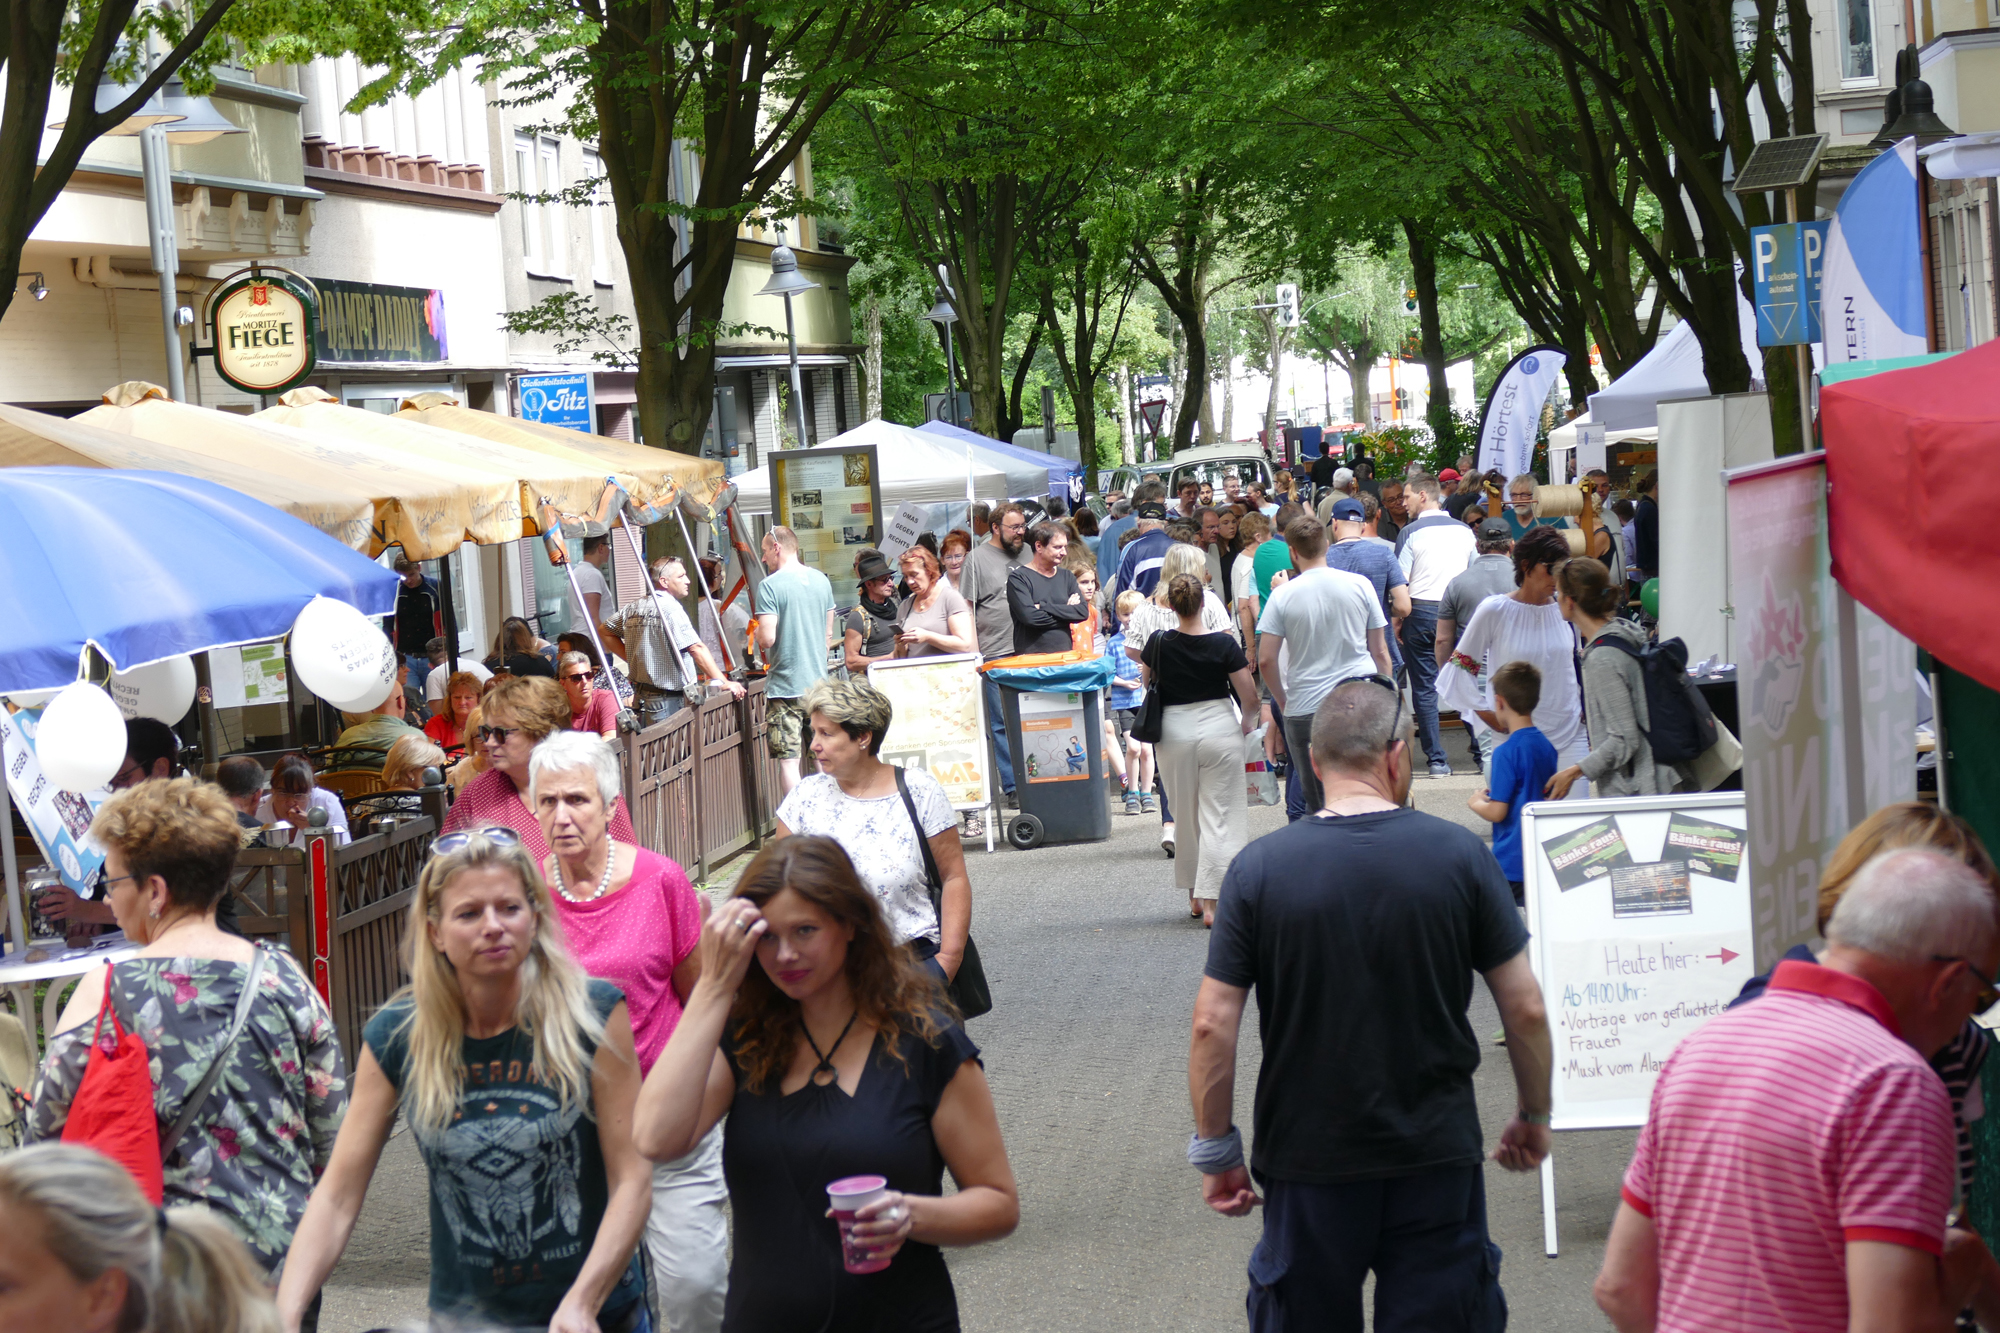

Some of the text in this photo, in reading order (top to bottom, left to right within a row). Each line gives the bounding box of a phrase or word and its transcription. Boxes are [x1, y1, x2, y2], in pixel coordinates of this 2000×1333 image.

[1755, 233, 1778, 282] P
[1804, 229, 1821, 278] P
[1769, 284, 1795, 294] automat
[242, 319, 278, 329] MORITZ
[324, 290, 421, 351] DAMPF DADDY
[228, 322, 294, 350] FIEGE
[263, 360, 279, 368] 1878
[521, 375, 586, 388] Sicherheitstechnik
[547, 387, 587, 411] Titz
[1490, 383, 1518, 453] Hörtest
[1524, 415, 1535, 442] sofort
[895, 522, 915, 537] GEGEN
[902, 511, 919, 525] OMAS
[887, 533, 911, 549] RECHTS
[882, 738, 977, 752] Wir danken den Sponsoren
[11, 748, 29, 779] GEGEN
[27, 773, 47, 809] RECHTS
[1552, 846, 1590, 867] Bänke
[1590, 829, 1620, 852] raus!
[1669, 832, 1708, 847] Bänke
[1709, 838, 1741, 852] raus!
[1604, 941, 1699, 976] Heute hier:
[1562, 984, 1582, 1008] Ab
[1616, 981, 1647, 1003] Uhr:
[1565, 1008, 1626, 1036] Vorträge
[1635, 1010, 1658, 1023] von
[1569, 1036, 1621, 1052] Frauen
[1568, 1056, 1604, 1080] Musik
[1607, 1062, 1634, 1077] vom
[540, 1241, 583, 1262] VALLEY
